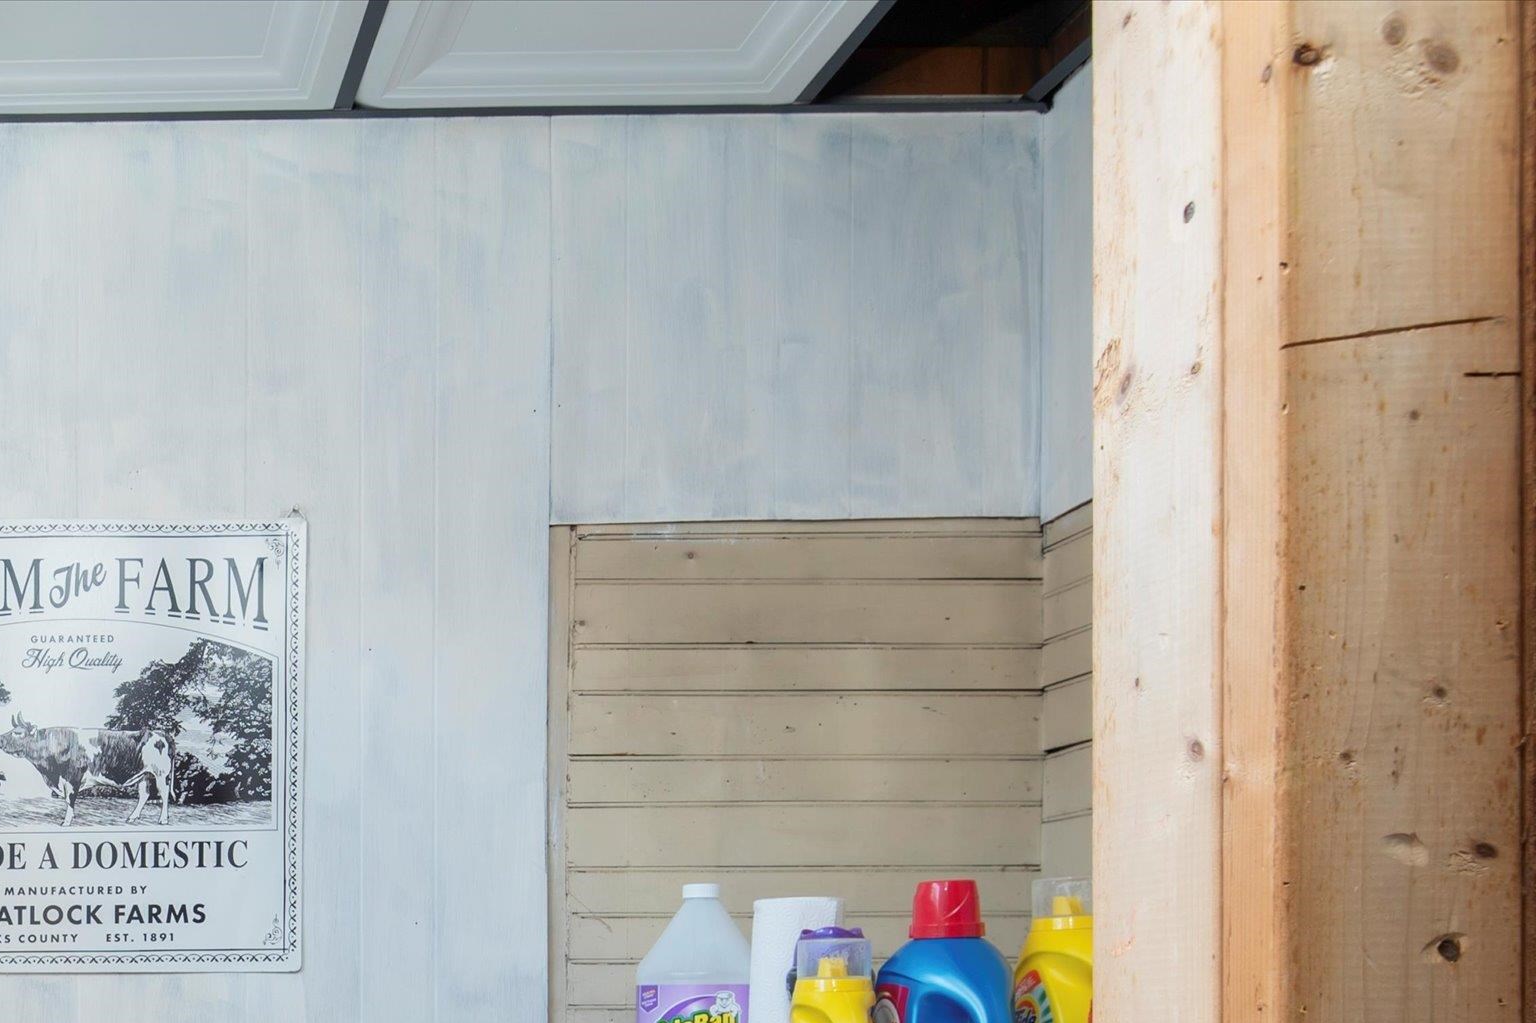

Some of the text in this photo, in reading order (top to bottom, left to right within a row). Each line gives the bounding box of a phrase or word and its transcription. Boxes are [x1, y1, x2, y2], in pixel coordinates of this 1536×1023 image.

[49, 562, 107, 609] The
[114, 556, 269, 630] FARM
[30, 634, 116, 644] GUARANTEED
[21, 646, 124, 673] High Quality
[38, 841, 60, 870] A
[71, 838, 249, 870] DOMESTIC
[4, 884, 149, 896] MANUFACTURED BY
[114, 902, 207, 925] FARMS
[18, 933, 79, 944] COUNTY
[106, 932, 135, 943] EST.
[142, 932, 176, 942] 1891
